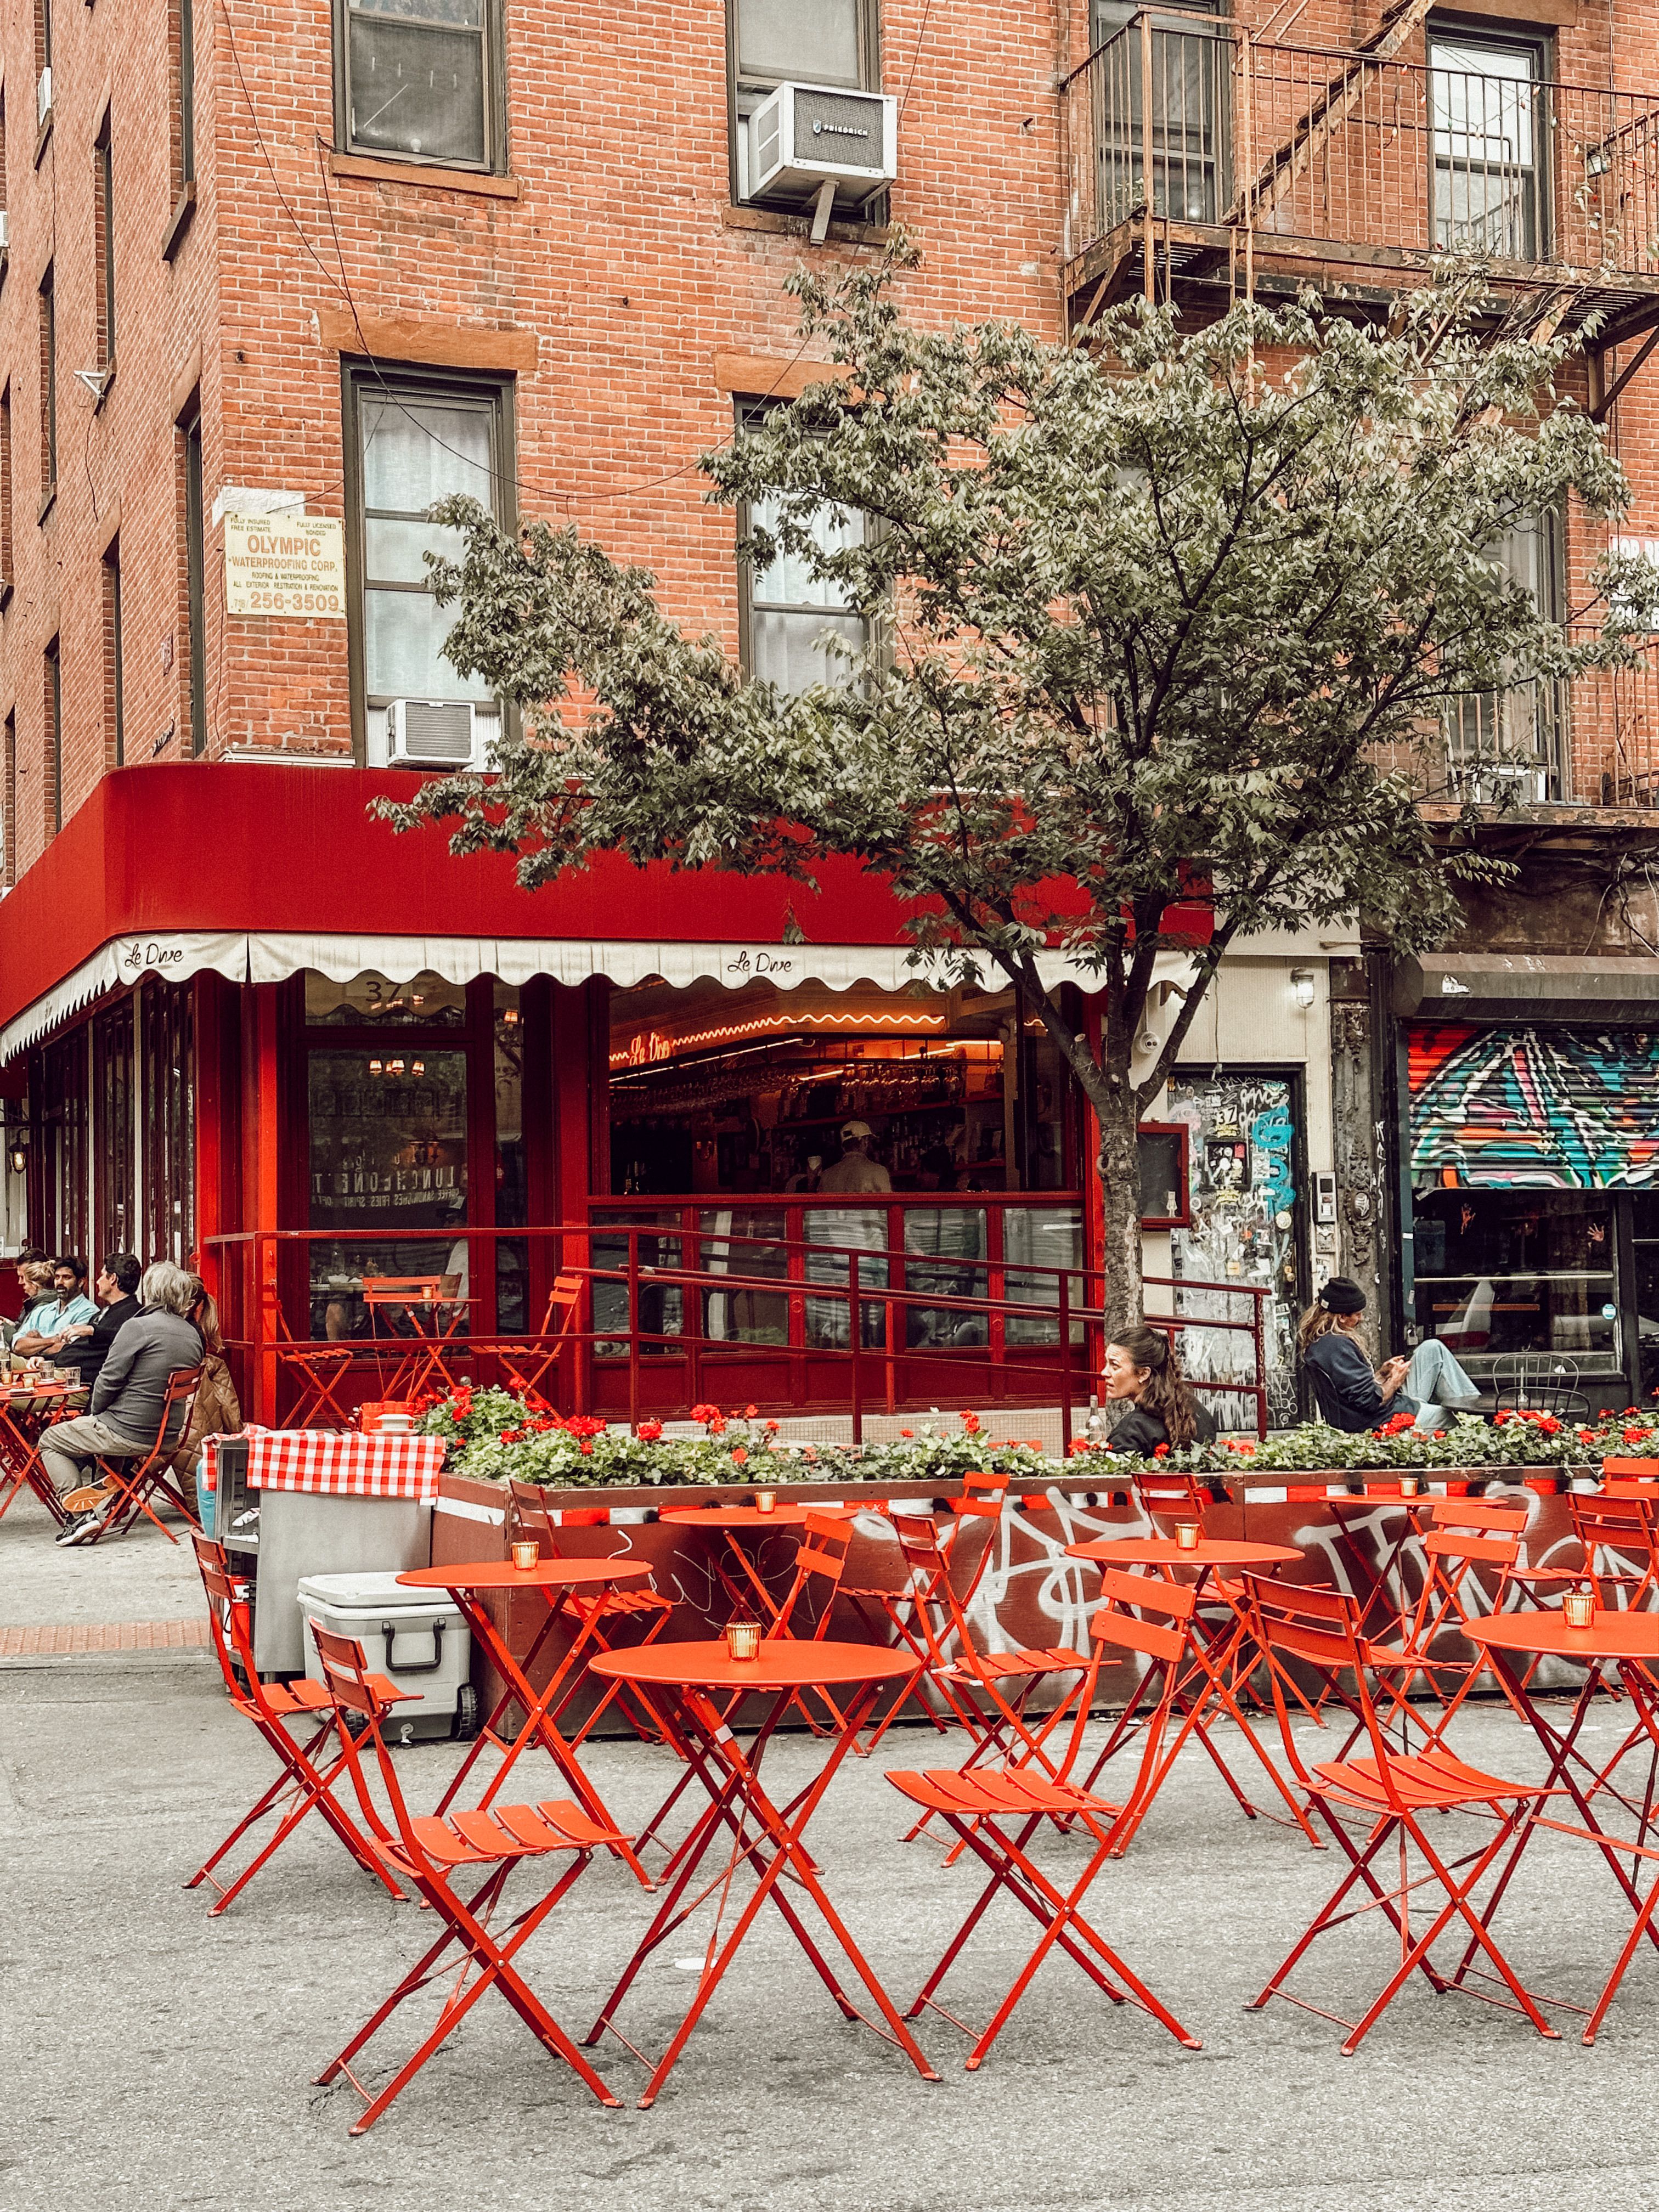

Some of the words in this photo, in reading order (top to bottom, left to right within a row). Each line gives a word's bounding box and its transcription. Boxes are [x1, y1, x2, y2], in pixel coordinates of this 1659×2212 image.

[824, 124, 868, 136] FRIEDRICH
[247, 535, 321, 556] OLYMPIC
[232, 556, 308, 570] WATERPROOFING
[252, 572, 273, 580] ROOFING
[280, 573, 320, 582] WATERPROOFING
[309, 584, 339, 592] RENOVATION
[250, 591, 339, 612] 256-3509
[125, 943, 142, 969] Le
[146, 943, 184, 964] Dive
[727, 951, 751, 973] Le
[755, 952, 793, 973] Dive
[365, 981, 402, 1002] 37
[1218, 1107, 1236, 1125] 37
